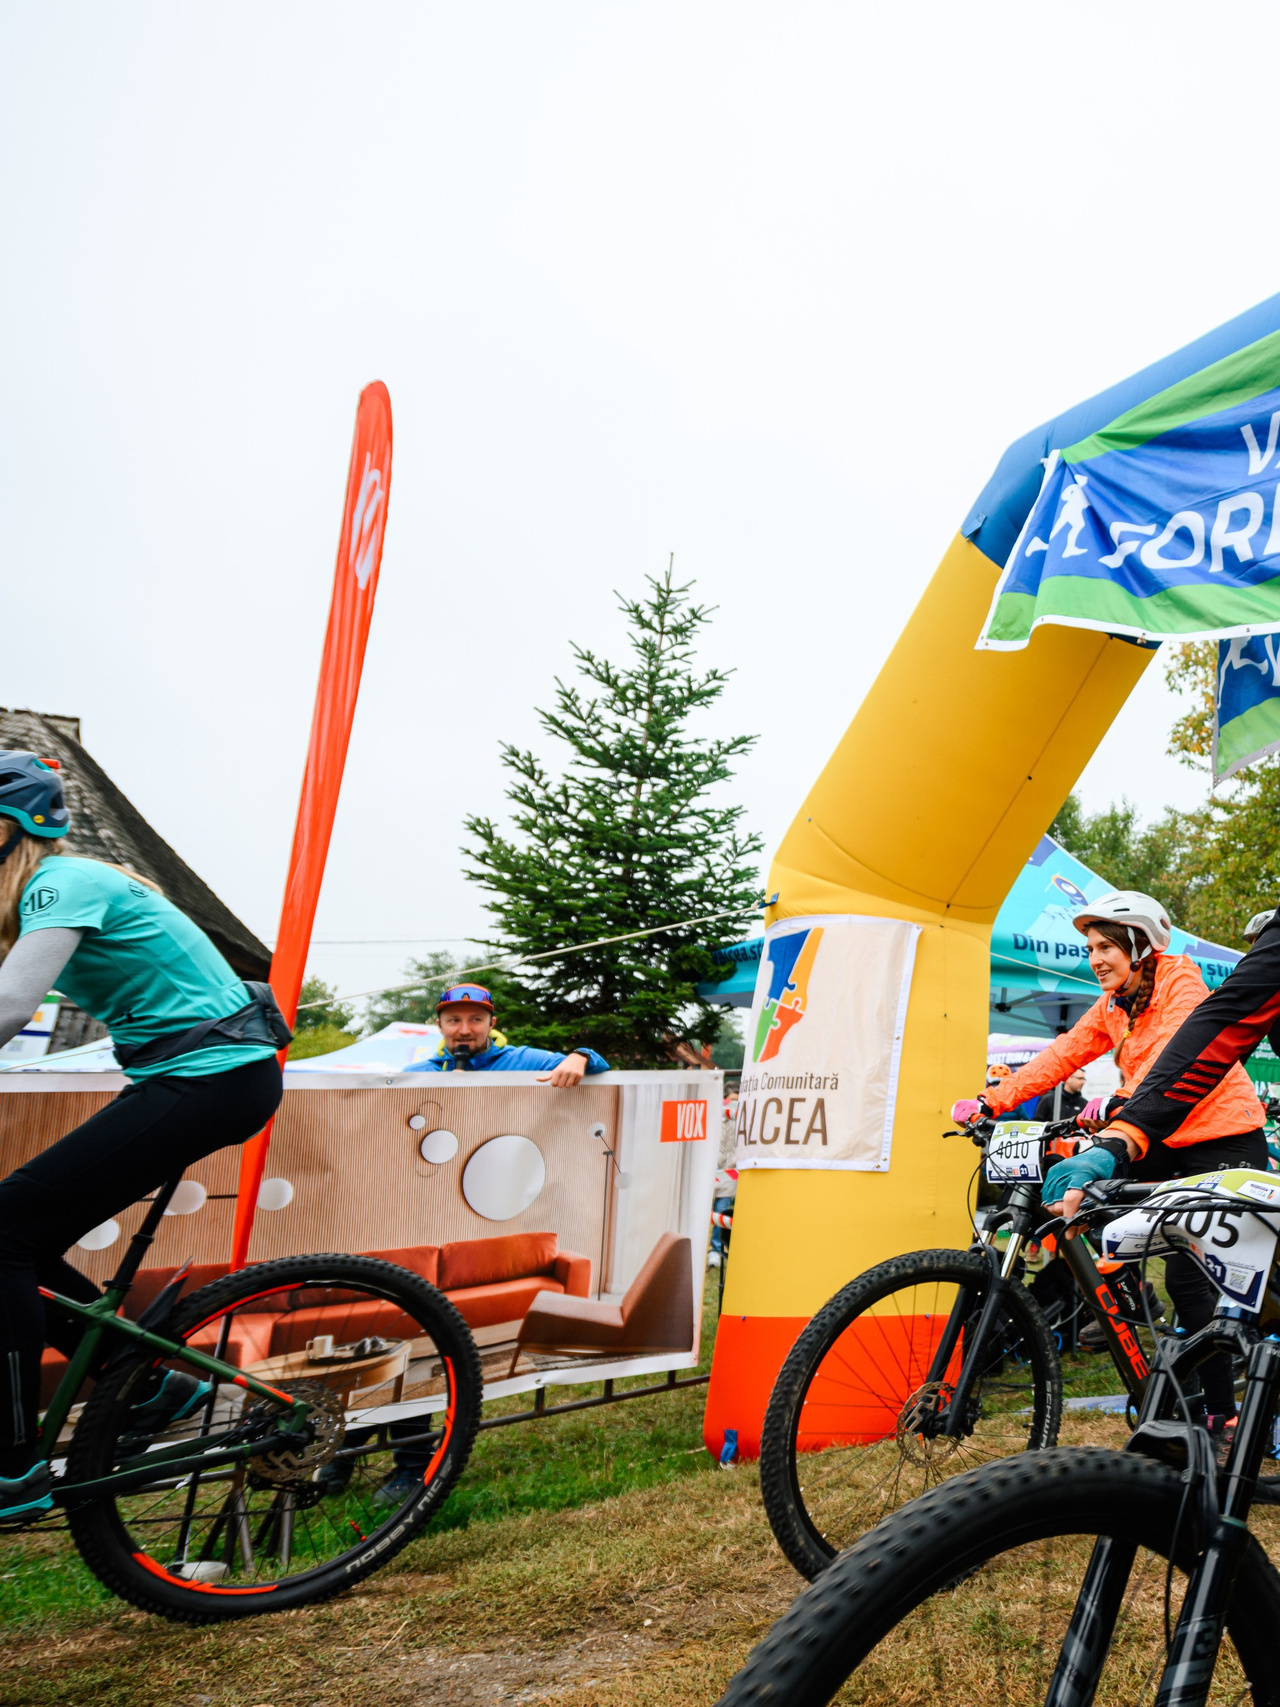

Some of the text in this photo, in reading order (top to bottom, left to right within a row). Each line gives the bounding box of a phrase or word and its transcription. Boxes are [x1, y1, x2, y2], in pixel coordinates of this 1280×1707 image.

[1012, 933, 1049, 954] Din
[760, 1071, 839, 1090] Comunitară
[676, 1102, 705, 1139] VOX
[735, 1096, 828, 1147] ALCEA
[996, 1140, 1030, 1160] 4010
[1206, 1257, 1222, 1278] 21
[1094, 1282, 1151, 1381] CUBE
[1040, 1380, 1052, 1450] SCHWA
